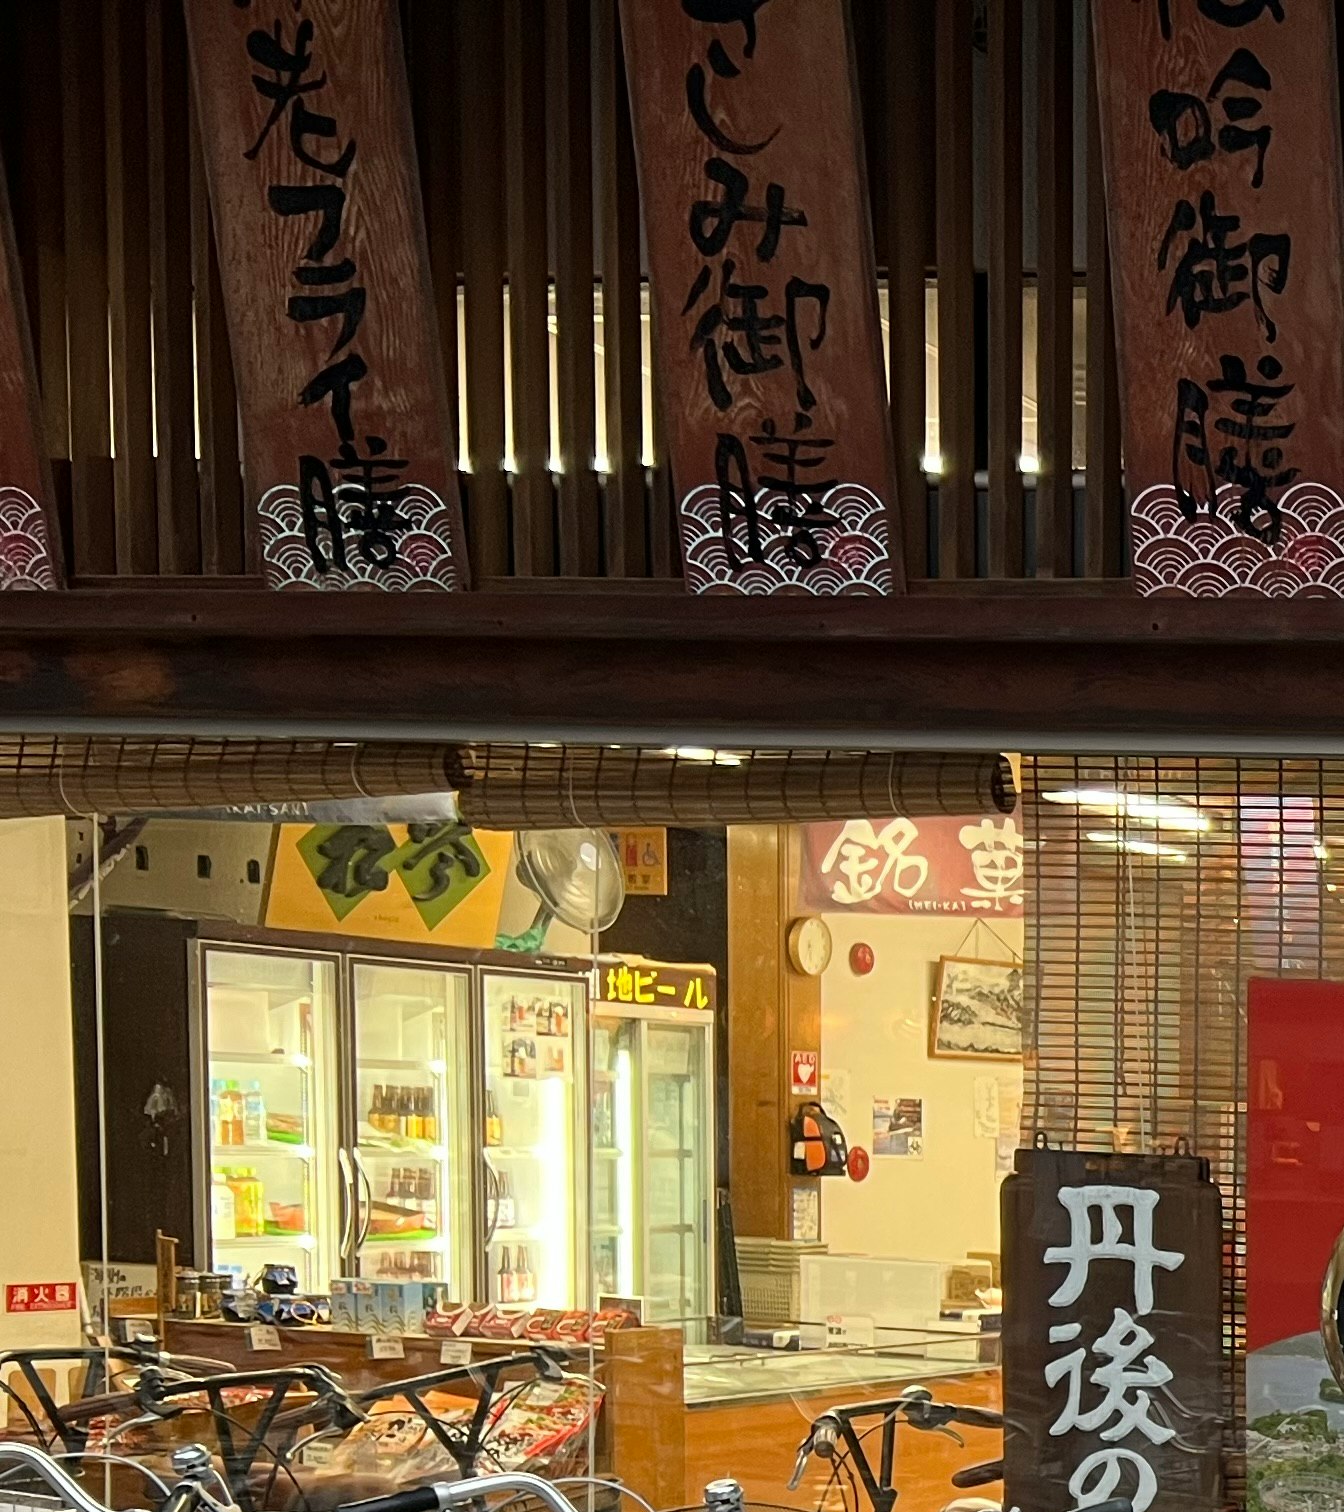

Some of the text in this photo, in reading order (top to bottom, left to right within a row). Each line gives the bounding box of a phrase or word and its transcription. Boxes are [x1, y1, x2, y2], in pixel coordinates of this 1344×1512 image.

[236, 0, 413, 574] 老フライ膳
[607, 966, 709, 1009] 地ビール
